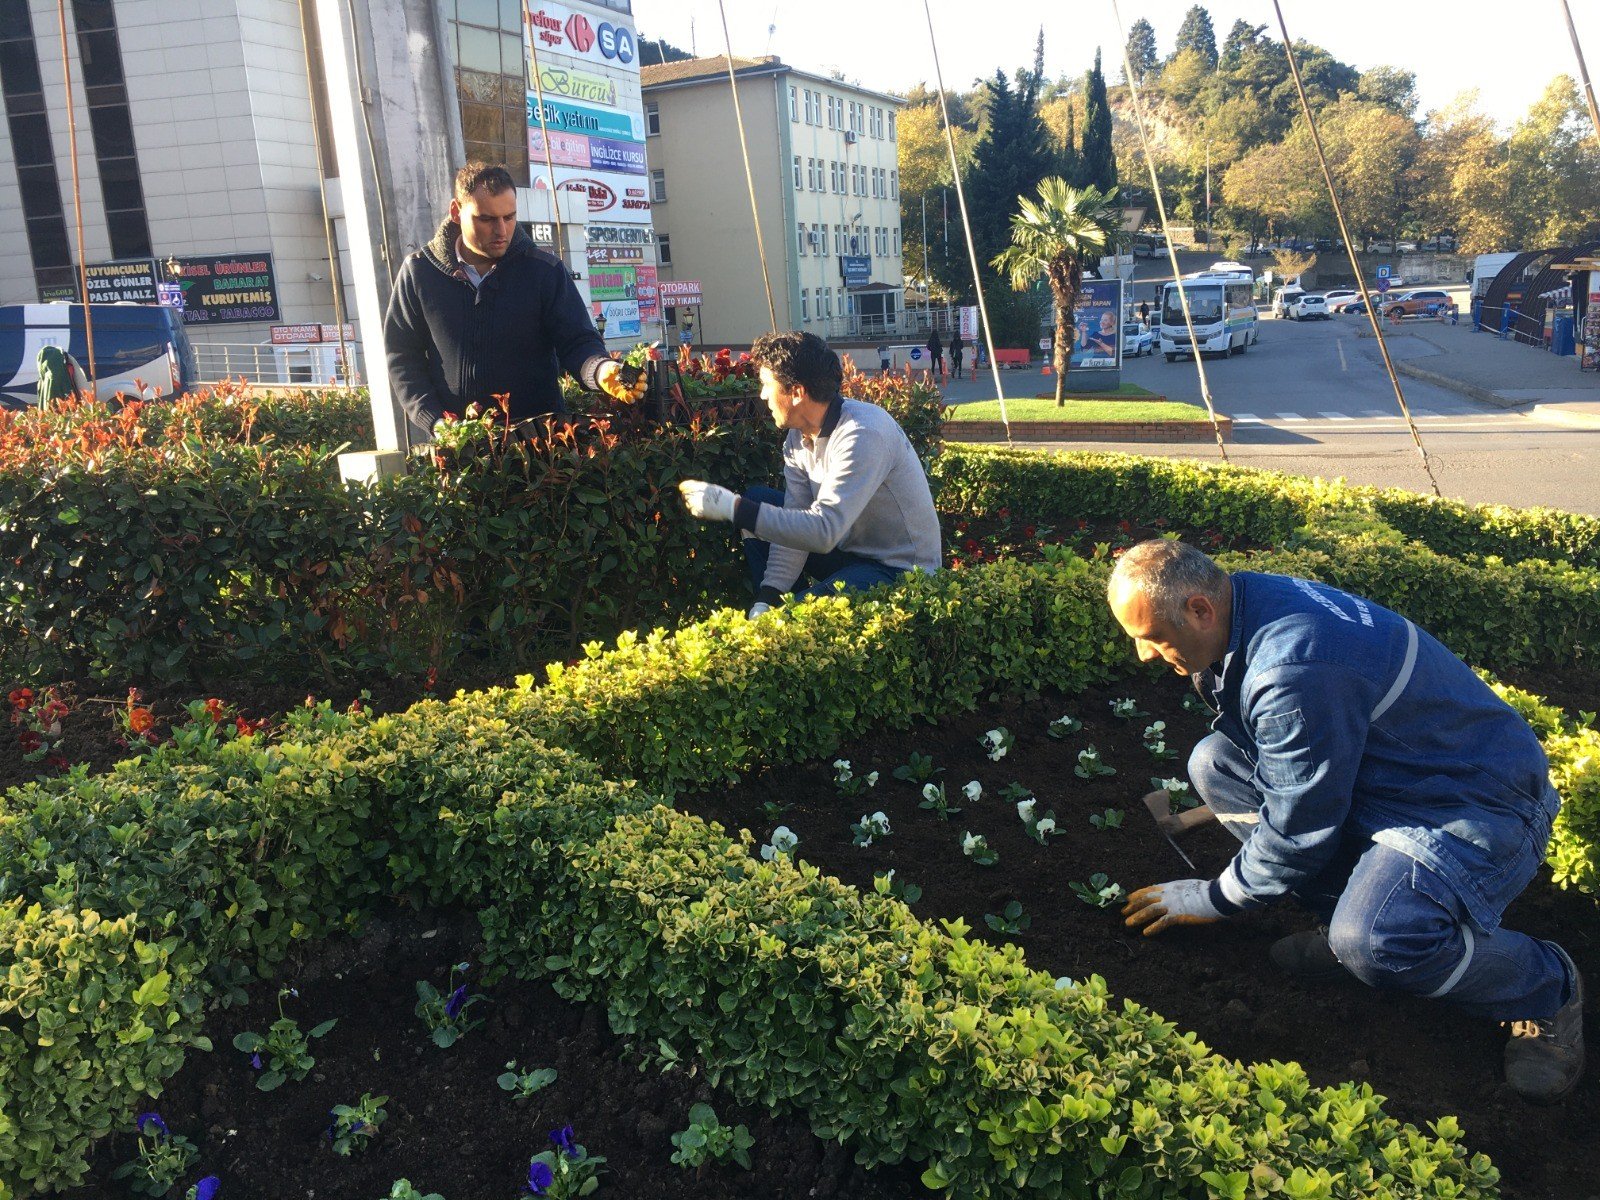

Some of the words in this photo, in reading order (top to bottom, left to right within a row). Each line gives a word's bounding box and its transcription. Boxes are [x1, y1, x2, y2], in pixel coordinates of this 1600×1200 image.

[590, 143, 622, 161] İNGİLİZCE
[622, 150, 644, 163] KURSU
[86, 264, 150, 277] KUYUMCULUK
[214, 261, 268, 275] ÜRÜNLER
[86, 279, 111, 289] ÖZEL
[113, 276, 152, 287] GÜNLER
[213, 276, 269, 290] BAHARAT
[660, 283, 700, 293] OTOPARK
[90, 293, 121, 303] PASTA
[123, 290, 156, 300] MALZ.
[202, 289, 272, 306] KURUYEMİŞ
[220, 307, 275, 319] TABACCO
[274, 332, 317, 340] OTOPARK
